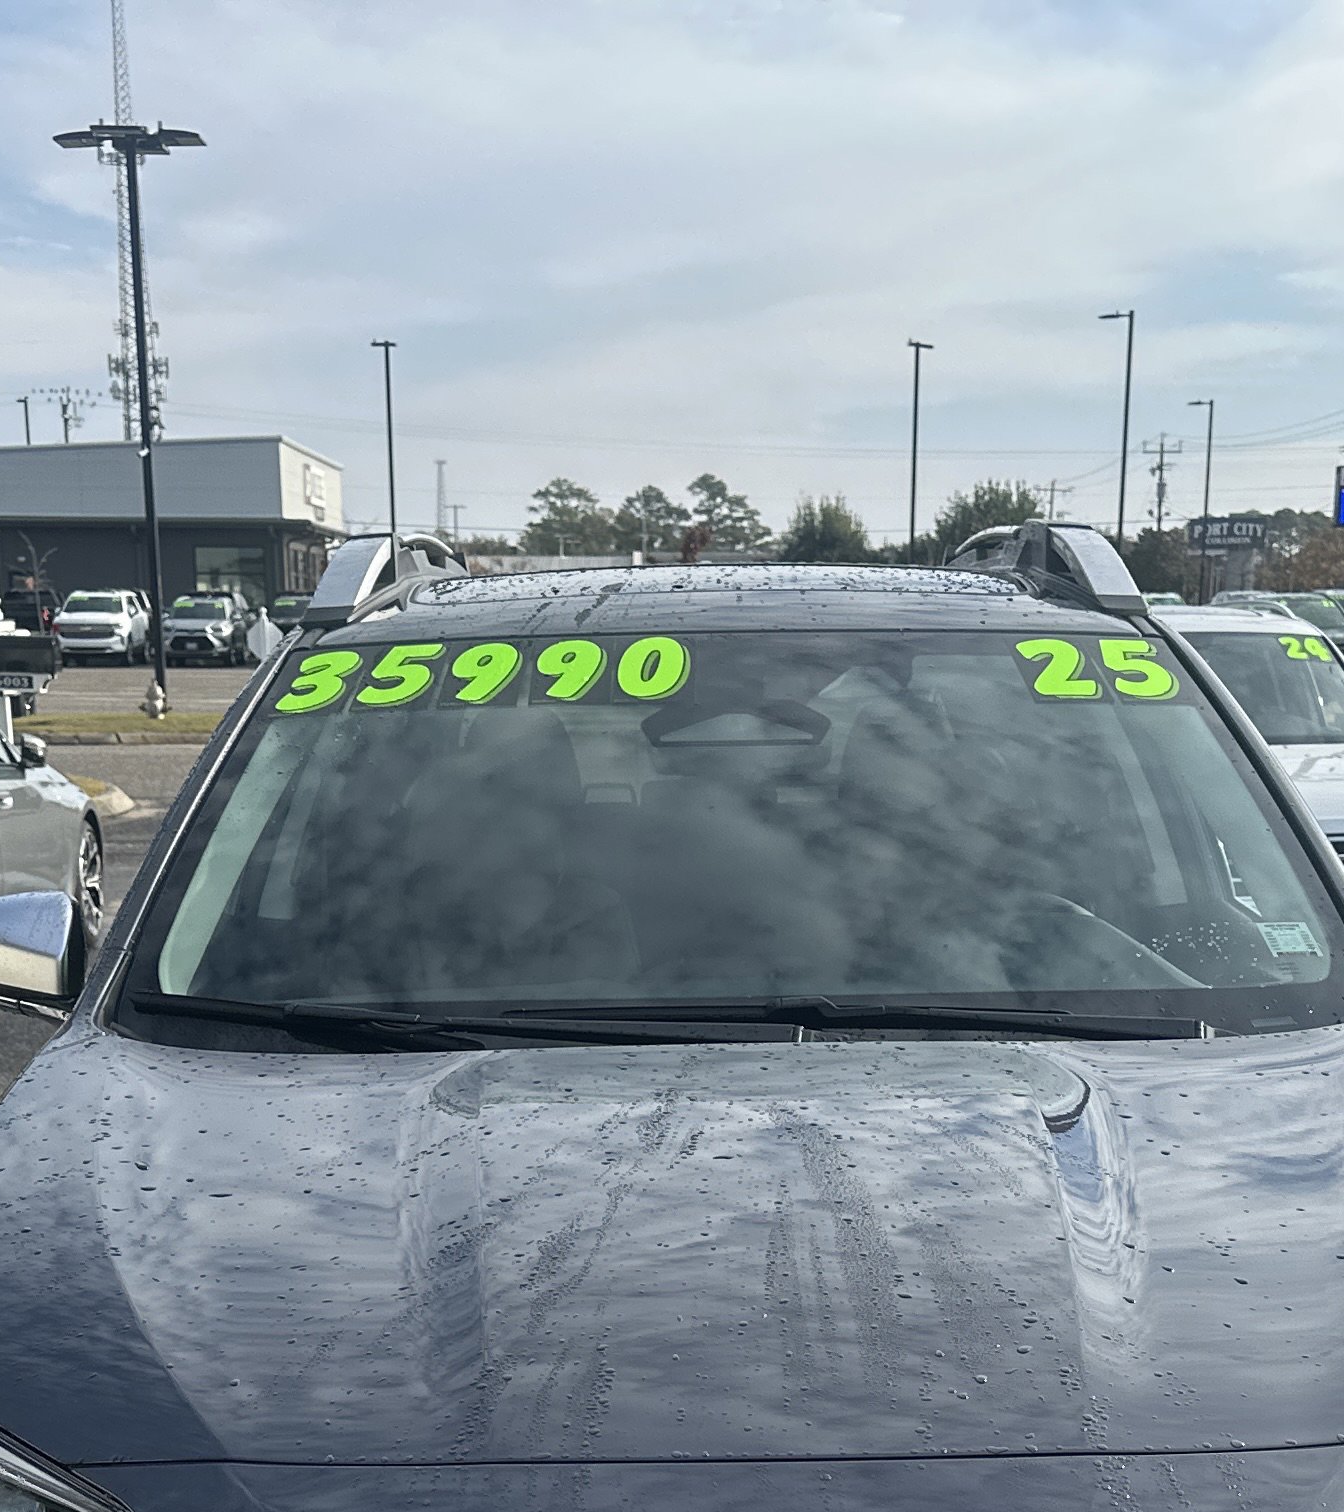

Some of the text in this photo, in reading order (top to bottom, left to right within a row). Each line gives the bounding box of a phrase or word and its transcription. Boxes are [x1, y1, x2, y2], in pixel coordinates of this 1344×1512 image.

[1233, 522, 1264, 537] CITY
[1278, 636, 1332, 662] 24
[275, 636, 1180, 713] 35990 25
